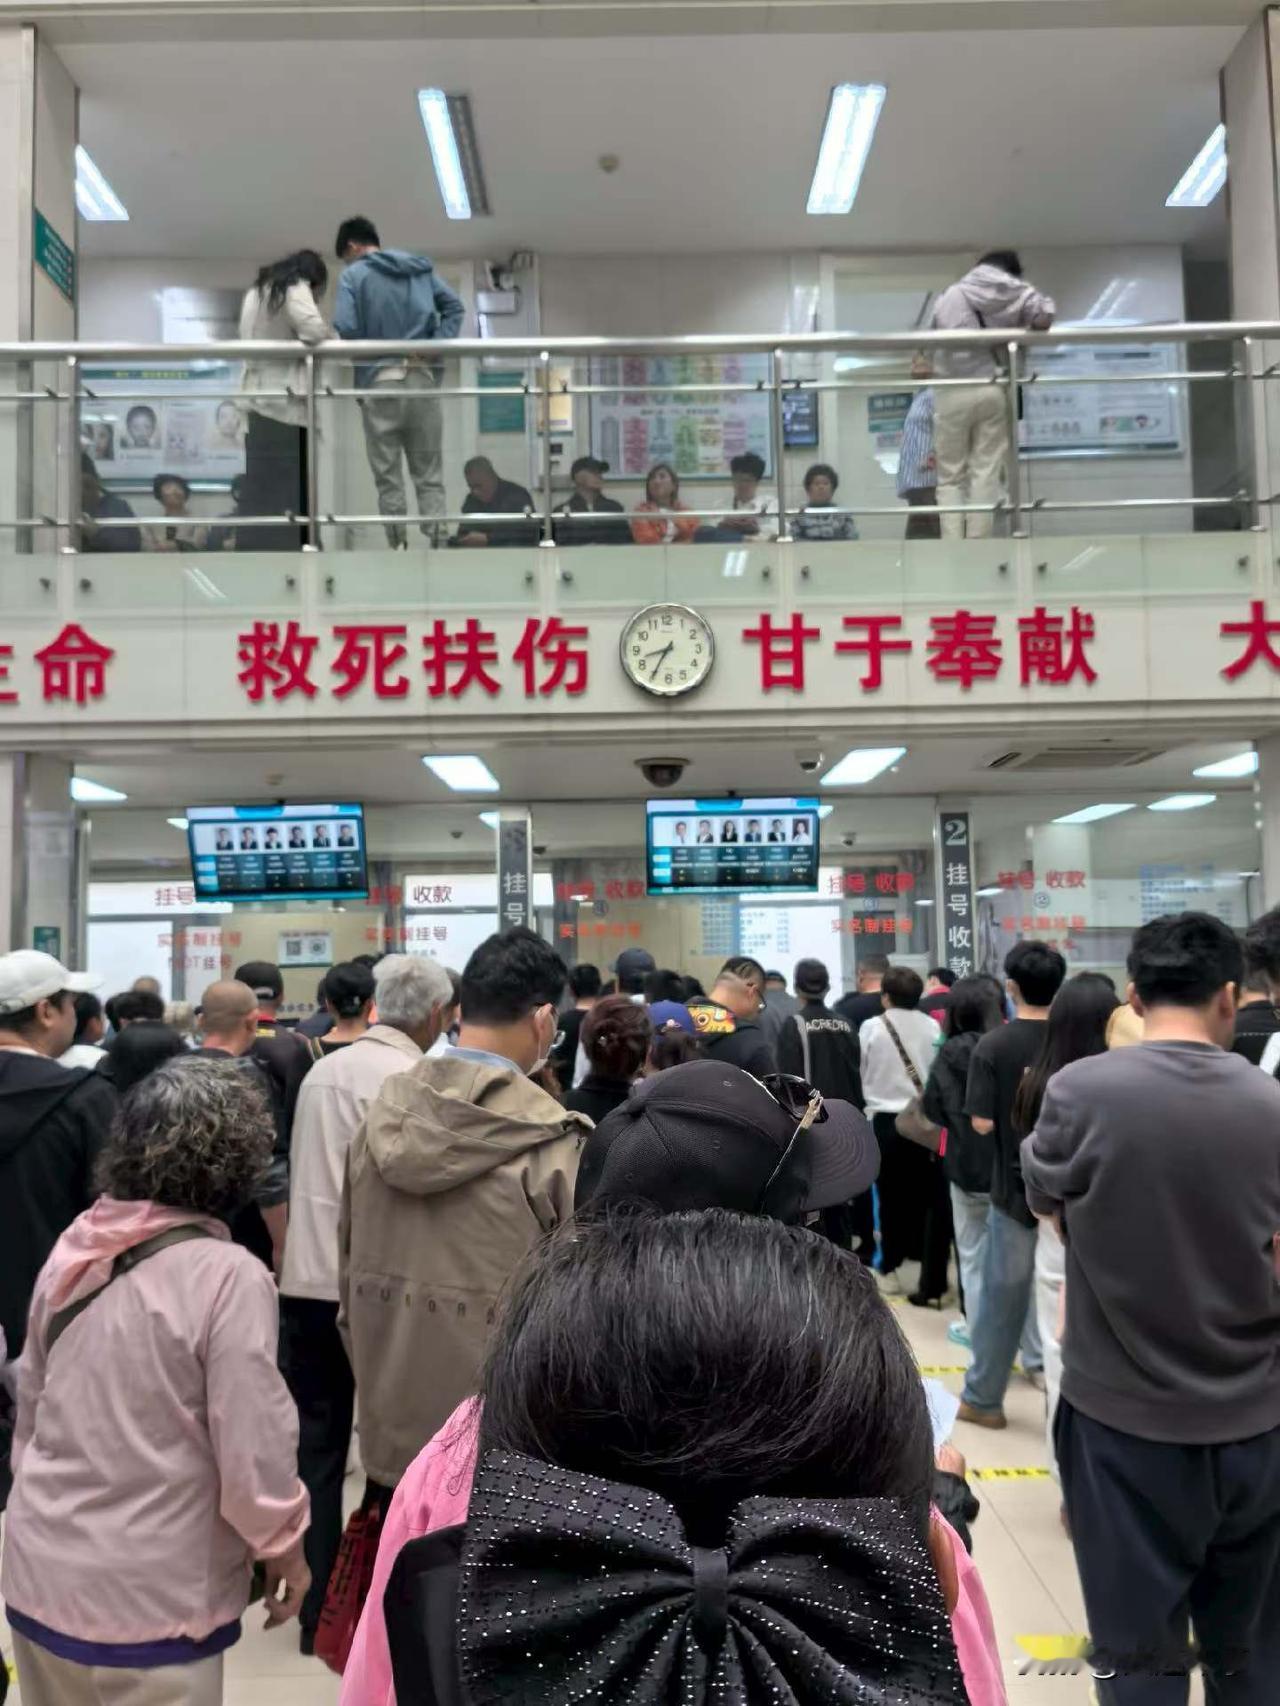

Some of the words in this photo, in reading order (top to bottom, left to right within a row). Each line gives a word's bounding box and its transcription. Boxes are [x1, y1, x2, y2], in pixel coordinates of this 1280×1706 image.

[648, 620, 657, 631] 11
[661, 615, 672, 626] 12
[639, 631, 649, 641] 10
[689, 629, 697, 640] 2
[0, 624, 115, 704] 命
[238, 617, 588, 700] 救死扶伤
[743, 607, 1096, 690] 甘于奉献
[1219, 601, 1280, 682] 大
[633, 646, 640, 656] 9
[695, 644, 702, 654] 3
[639, 660, 646, 671] 8
[691, 659, 698, 667] 4
[665, 674, 673, 684] 6
[679, 670, 686, 680] 5
[945, 819, 967, 846] 2
[1046, 870, 1086, 889] 收款
[155, 886, 195, 906] 挂号
[413, 885, 453, 904] 收款
[504, 871, 527, 927] 挂号
[946, 863, 972, 979] 挂号收款
